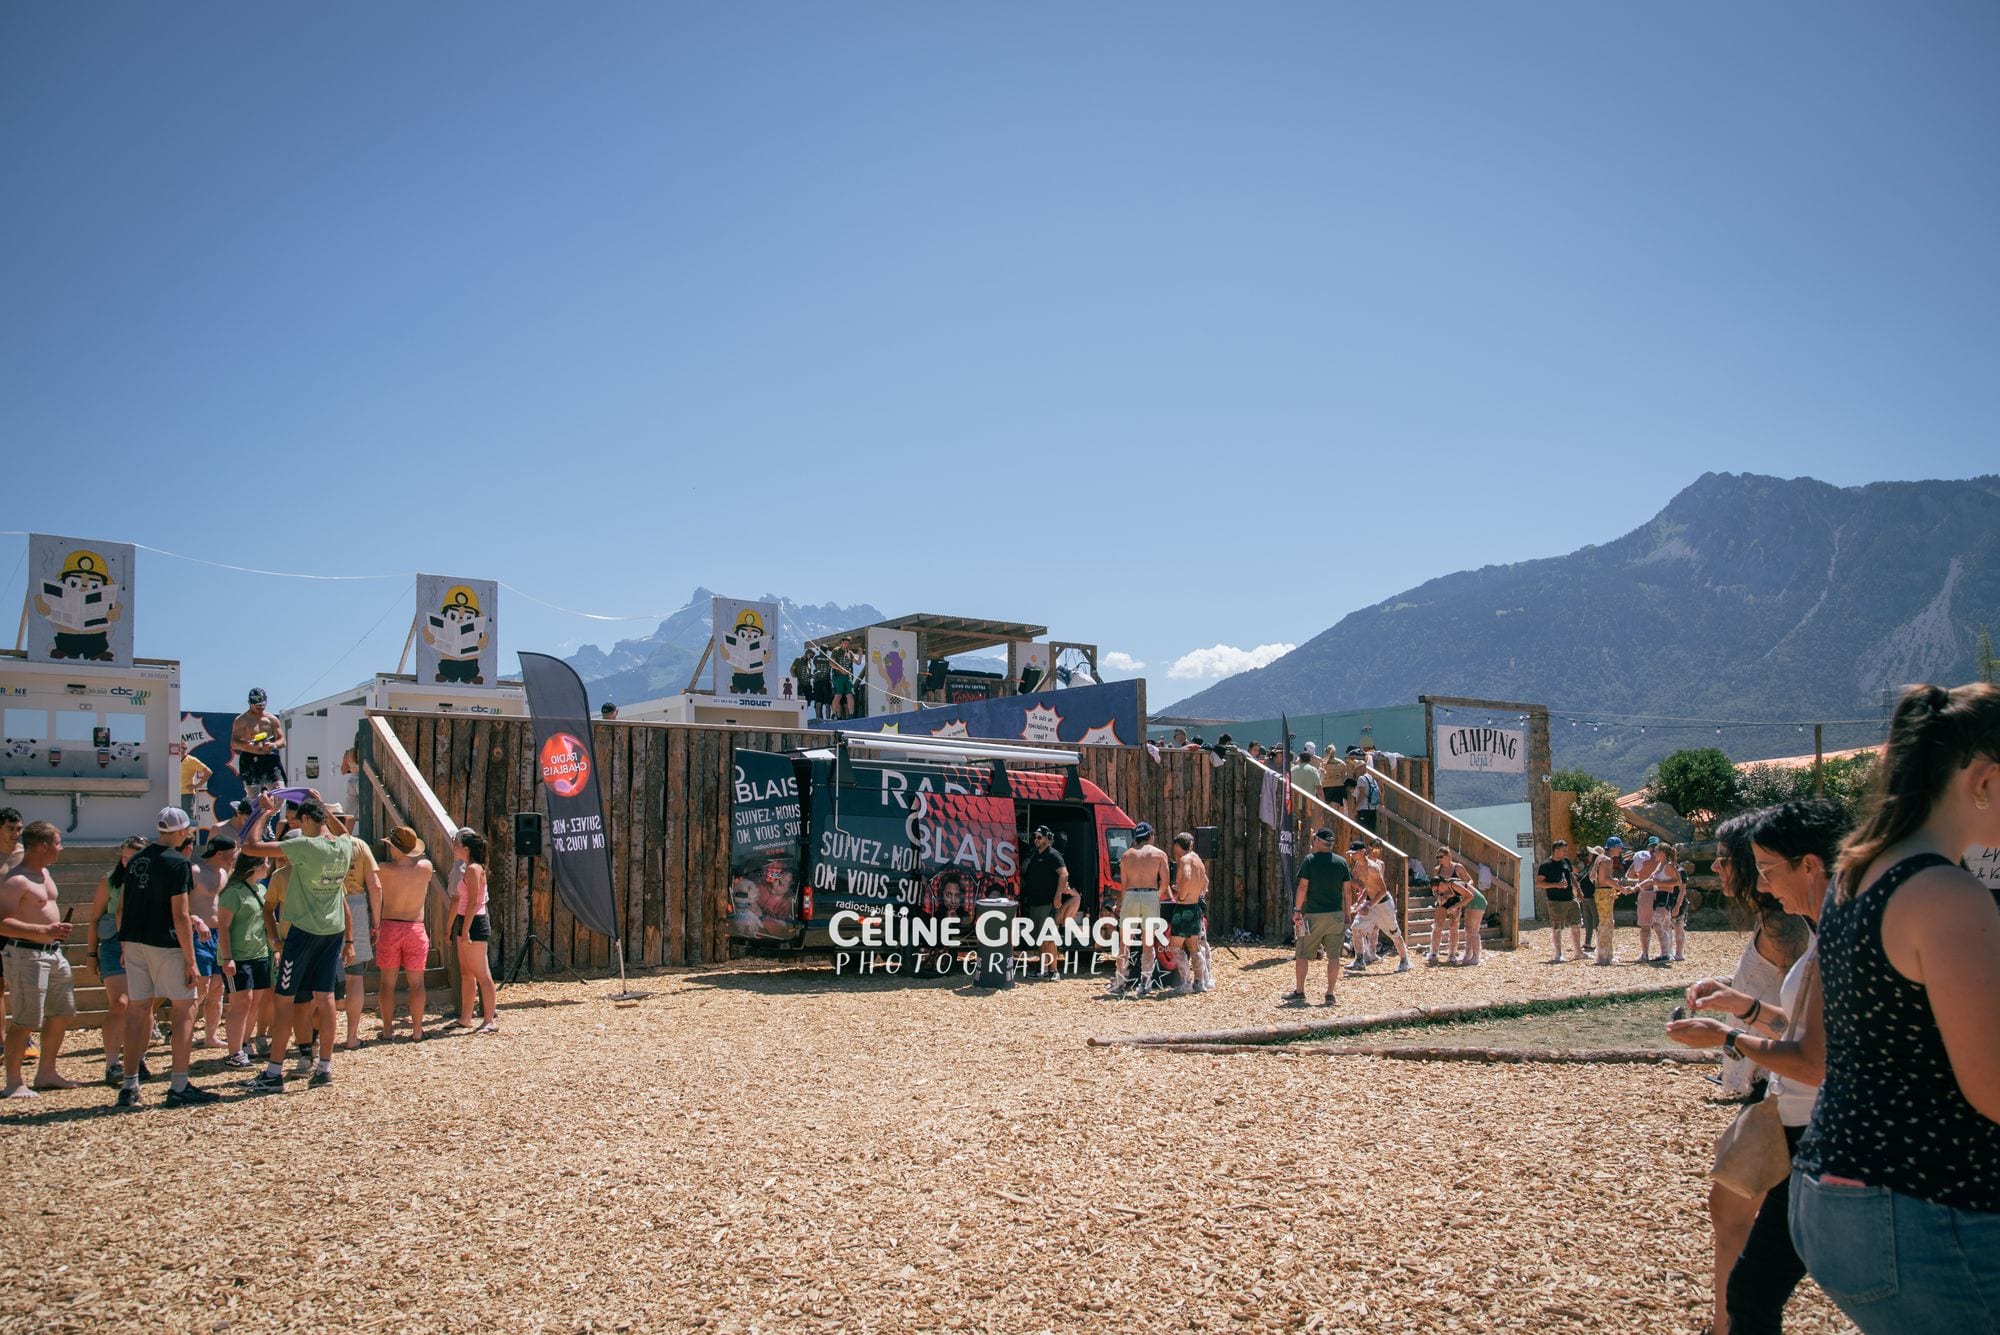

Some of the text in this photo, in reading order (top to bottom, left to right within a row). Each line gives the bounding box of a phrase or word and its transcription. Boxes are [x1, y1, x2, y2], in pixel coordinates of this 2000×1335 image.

[111, 686, 133, 696] cbc
[1449, 728, 1518, 760] CAMPING
[736, 828, 751, 844] ON
[754, 824, 780, 841] VOUS
[814, 862, 838, 891] ON
[847, 868, 890, 899] VOUS
